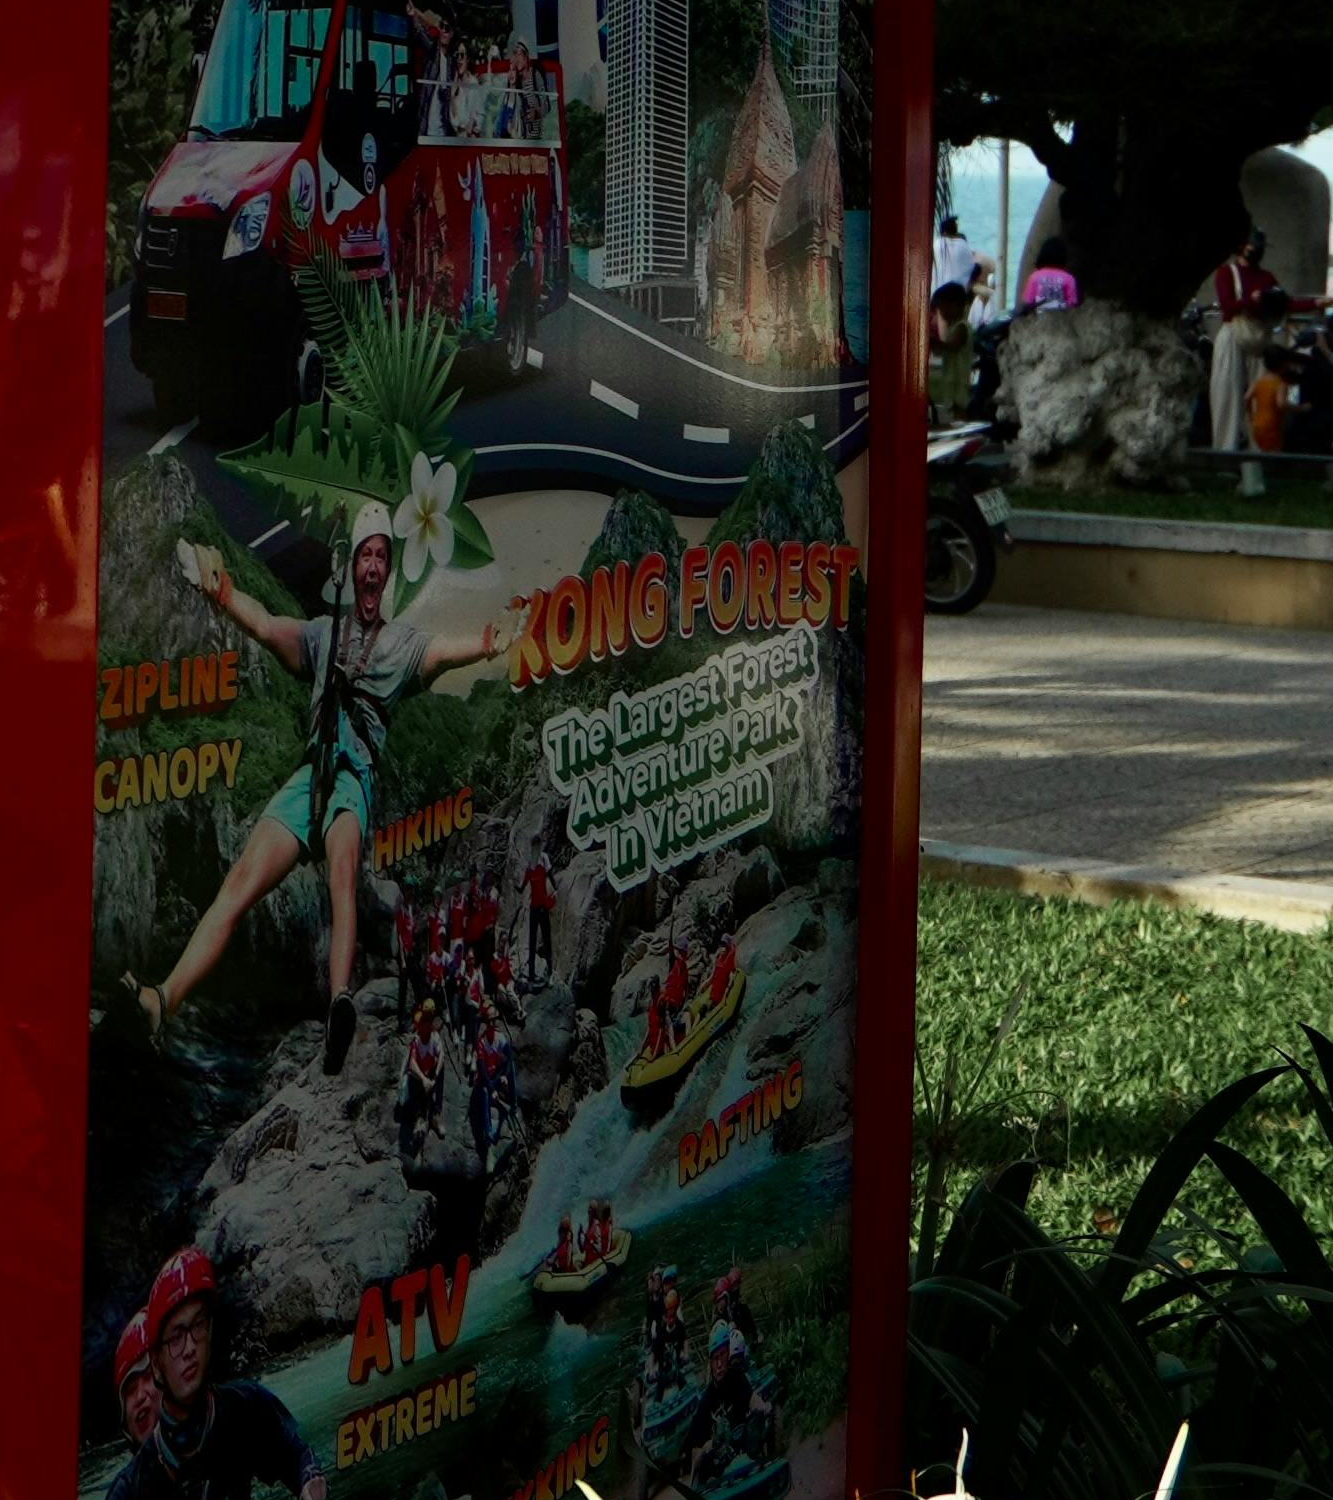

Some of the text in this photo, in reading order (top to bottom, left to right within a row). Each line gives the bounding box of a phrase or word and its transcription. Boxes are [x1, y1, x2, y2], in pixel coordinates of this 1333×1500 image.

[507, 541, 861, 692] KONG FOREST
[97, 650, 241, 724] ZIPLINE
[548, 630, 816, 782] The Largest Forest
[93, 737, 243, 816] CANOPY
[571, 692, 800, 827] Adventure Park
[372, 785, 475, 872] HIKING
[608, 765, 773, 880] In Vietnam
[676, 1060, 805, 1186] RAFTING
[348, 1252, 471, 1385] ATV
[337, 1371, 480, 1471] EXTREME
